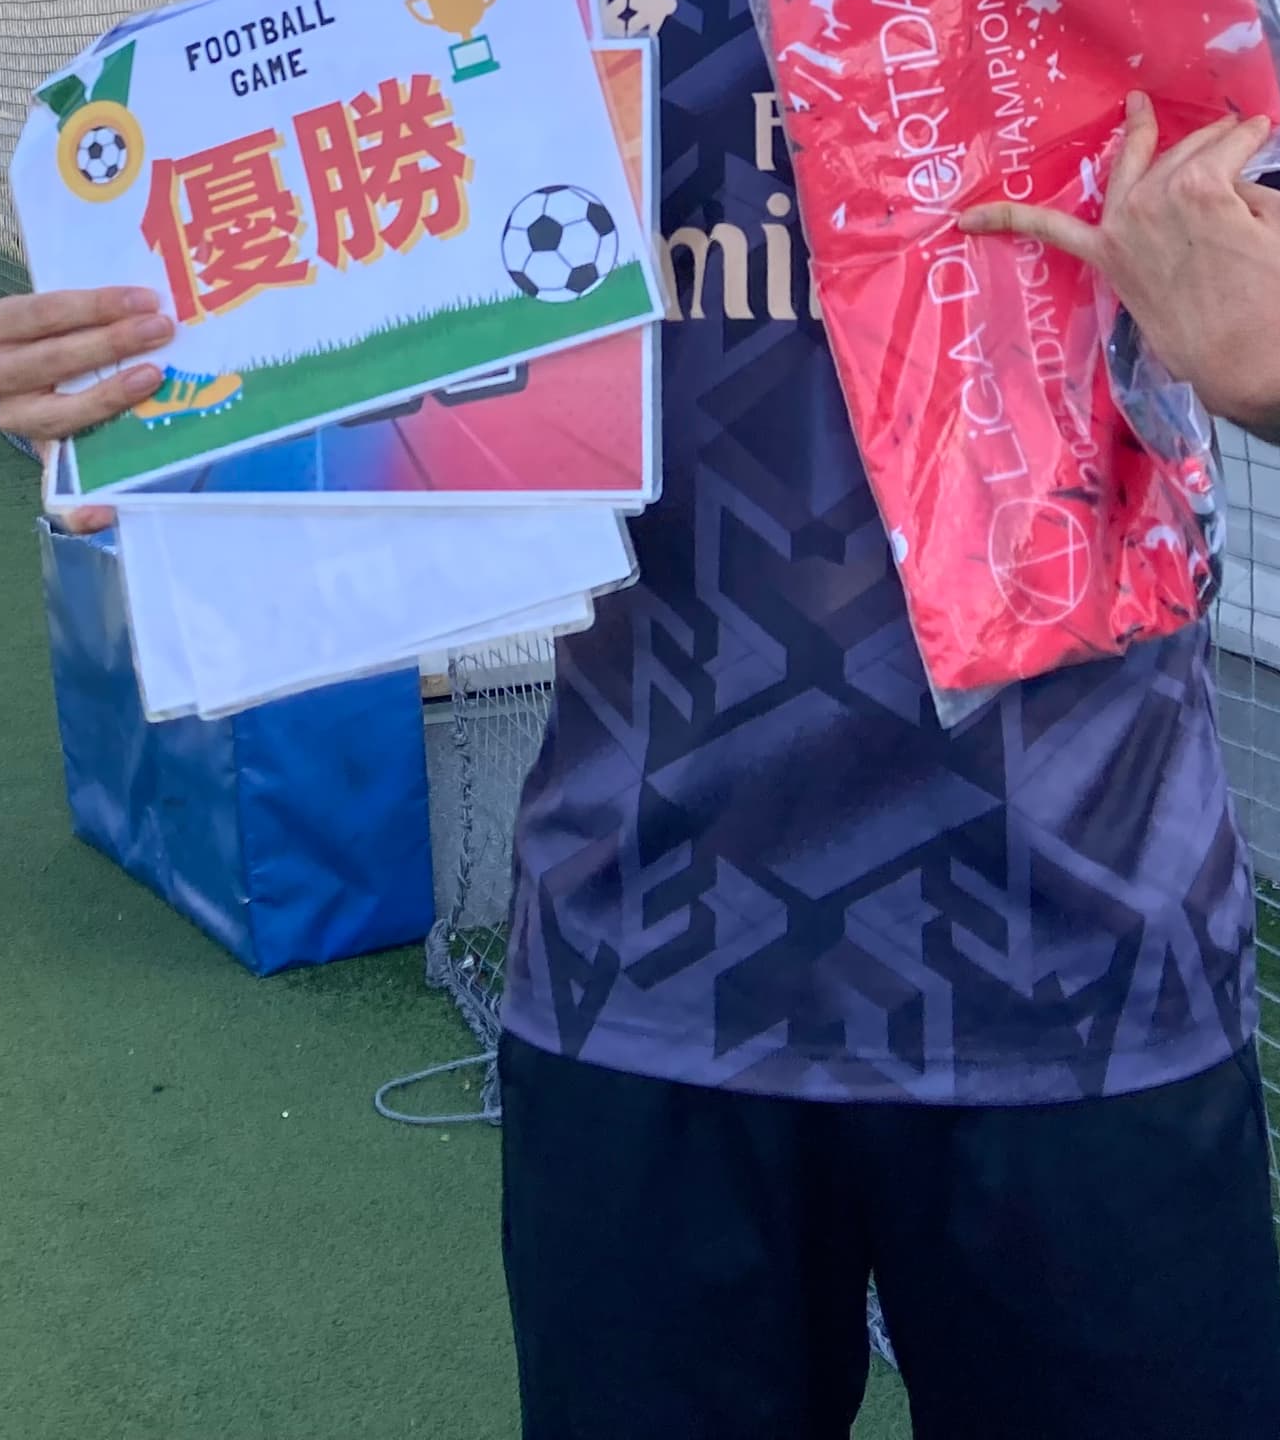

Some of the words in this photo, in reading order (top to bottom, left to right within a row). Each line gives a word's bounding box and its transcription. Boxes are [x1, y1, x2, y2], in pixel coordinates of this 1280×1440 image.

[185, 0, 335, 72] FOOTBALL
[231, 48, 308, 97] GAME
[140, 74, 475, 325] 優勝
